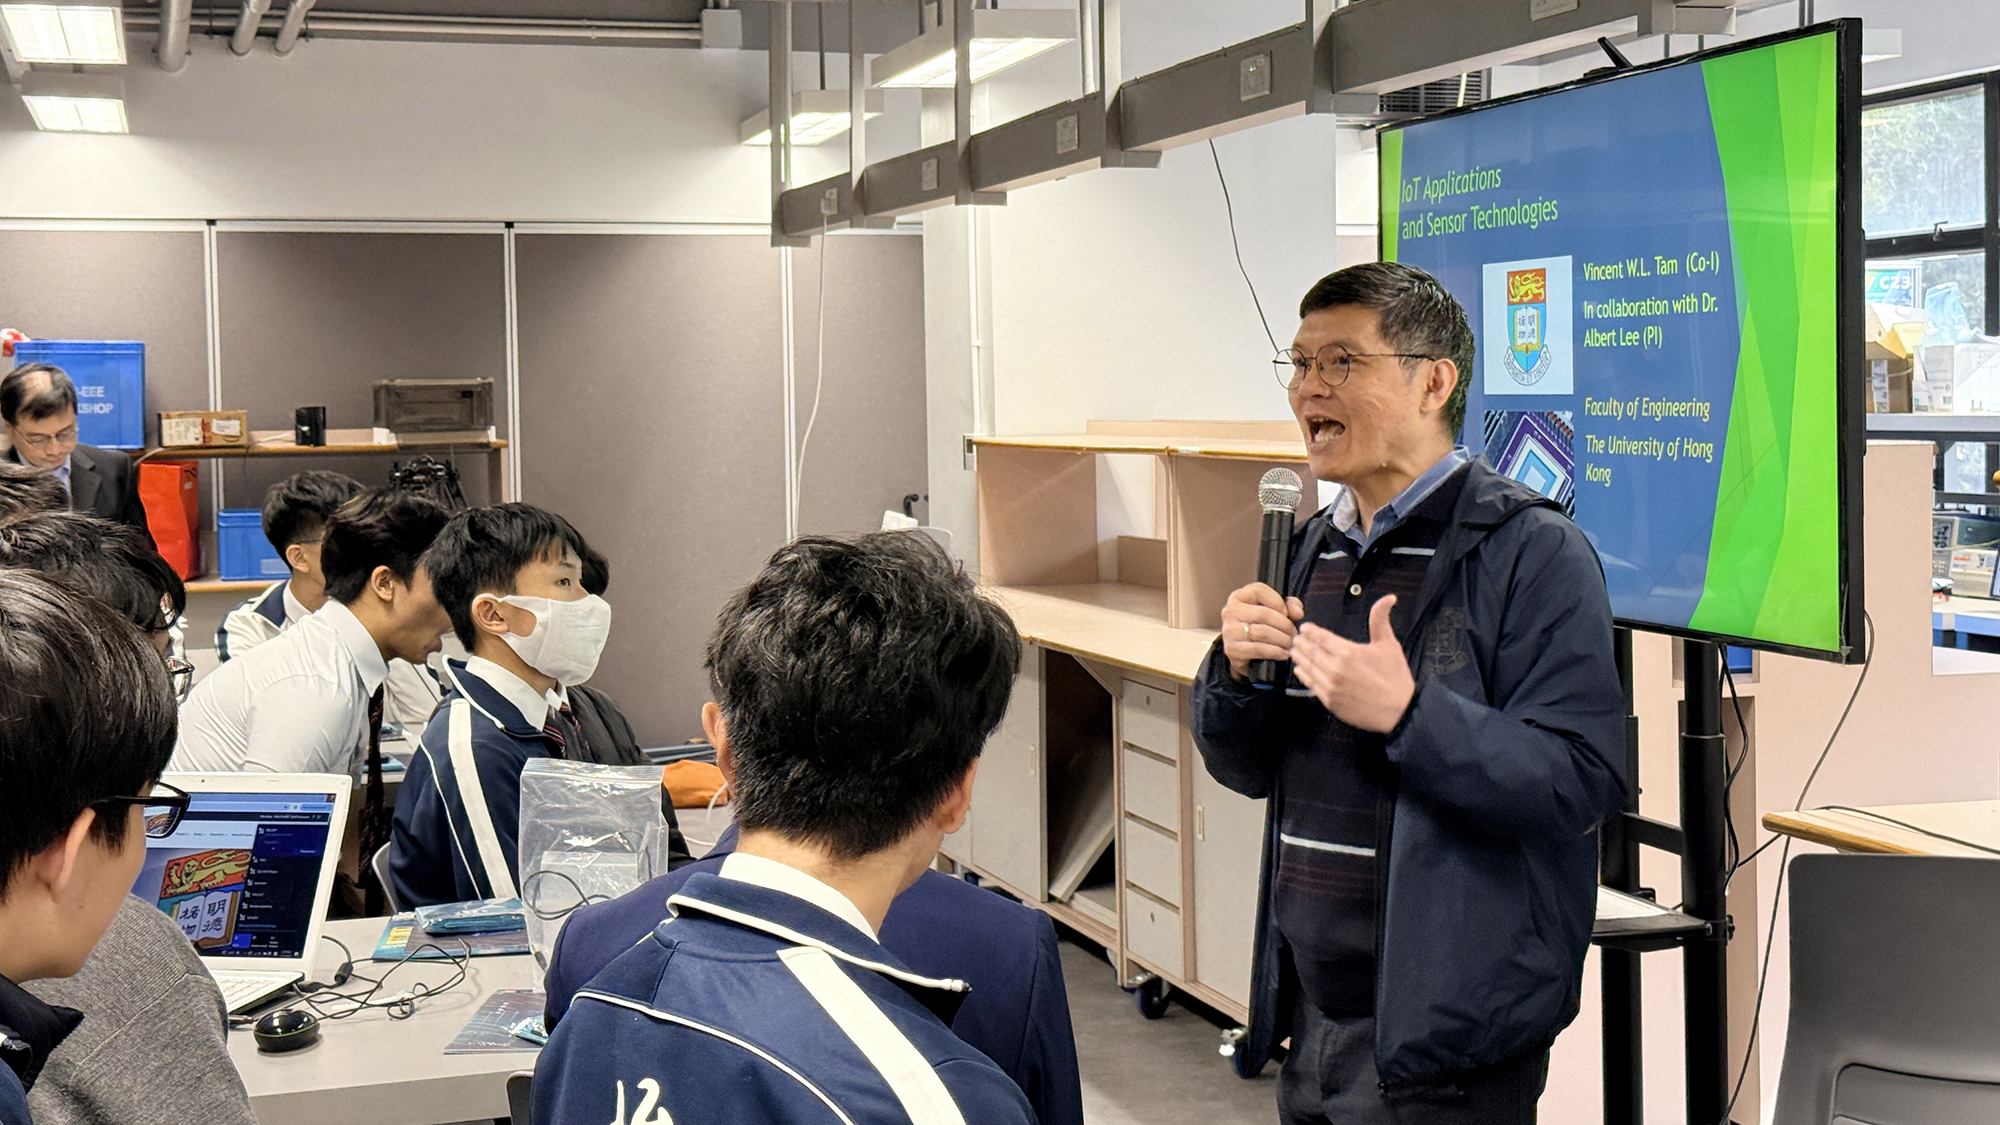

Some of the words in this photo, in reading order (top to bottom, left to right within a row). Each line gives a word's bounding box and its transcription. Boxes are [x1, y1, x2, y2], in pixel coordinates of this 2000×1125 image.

[1401, 176, 1421, 203] IoT
[1423, 166, 1502, 205] Applications
[1402, 213, 1424, 240] and
[1427, 212, 1467, 237] Sensor
[1470, 196, 1559, 230] Technologies
[1583, 261, 1624, 281] Vincent
[1626, 257, 1651, 278] W.L.
[1654, 255, 1679, 275] Tam
[1686, 250, 1720, 278] (Co-I)
[1878, 275, 1911, 290] C23
[1584, 300, 1594, 319] In
[1596, 296, 1669, 319] collaboration
[1672, 293, 1699, 314] with
[1702, 292, 1719, 312] Dr.
[1583, 327, 1617, 348] Albert
[1620, 327, 1640, 346] Lee
[1643, 325, 1663, 350] (PI)
[78, 386, 105, 398] -EEE
[1584, 397, 1624, 421] Faculty
[1626, 397, 1640, 420] of
[1641, 397, 1711, 422] Engineering
[1585, 434, 1605, 454] The
[1608, 435, 1664, 461] University
[1667, 437, 1681, 461] of
[1683, 437, 1714, 463] Hong
[1585, 463, 1612, 487] Kong
